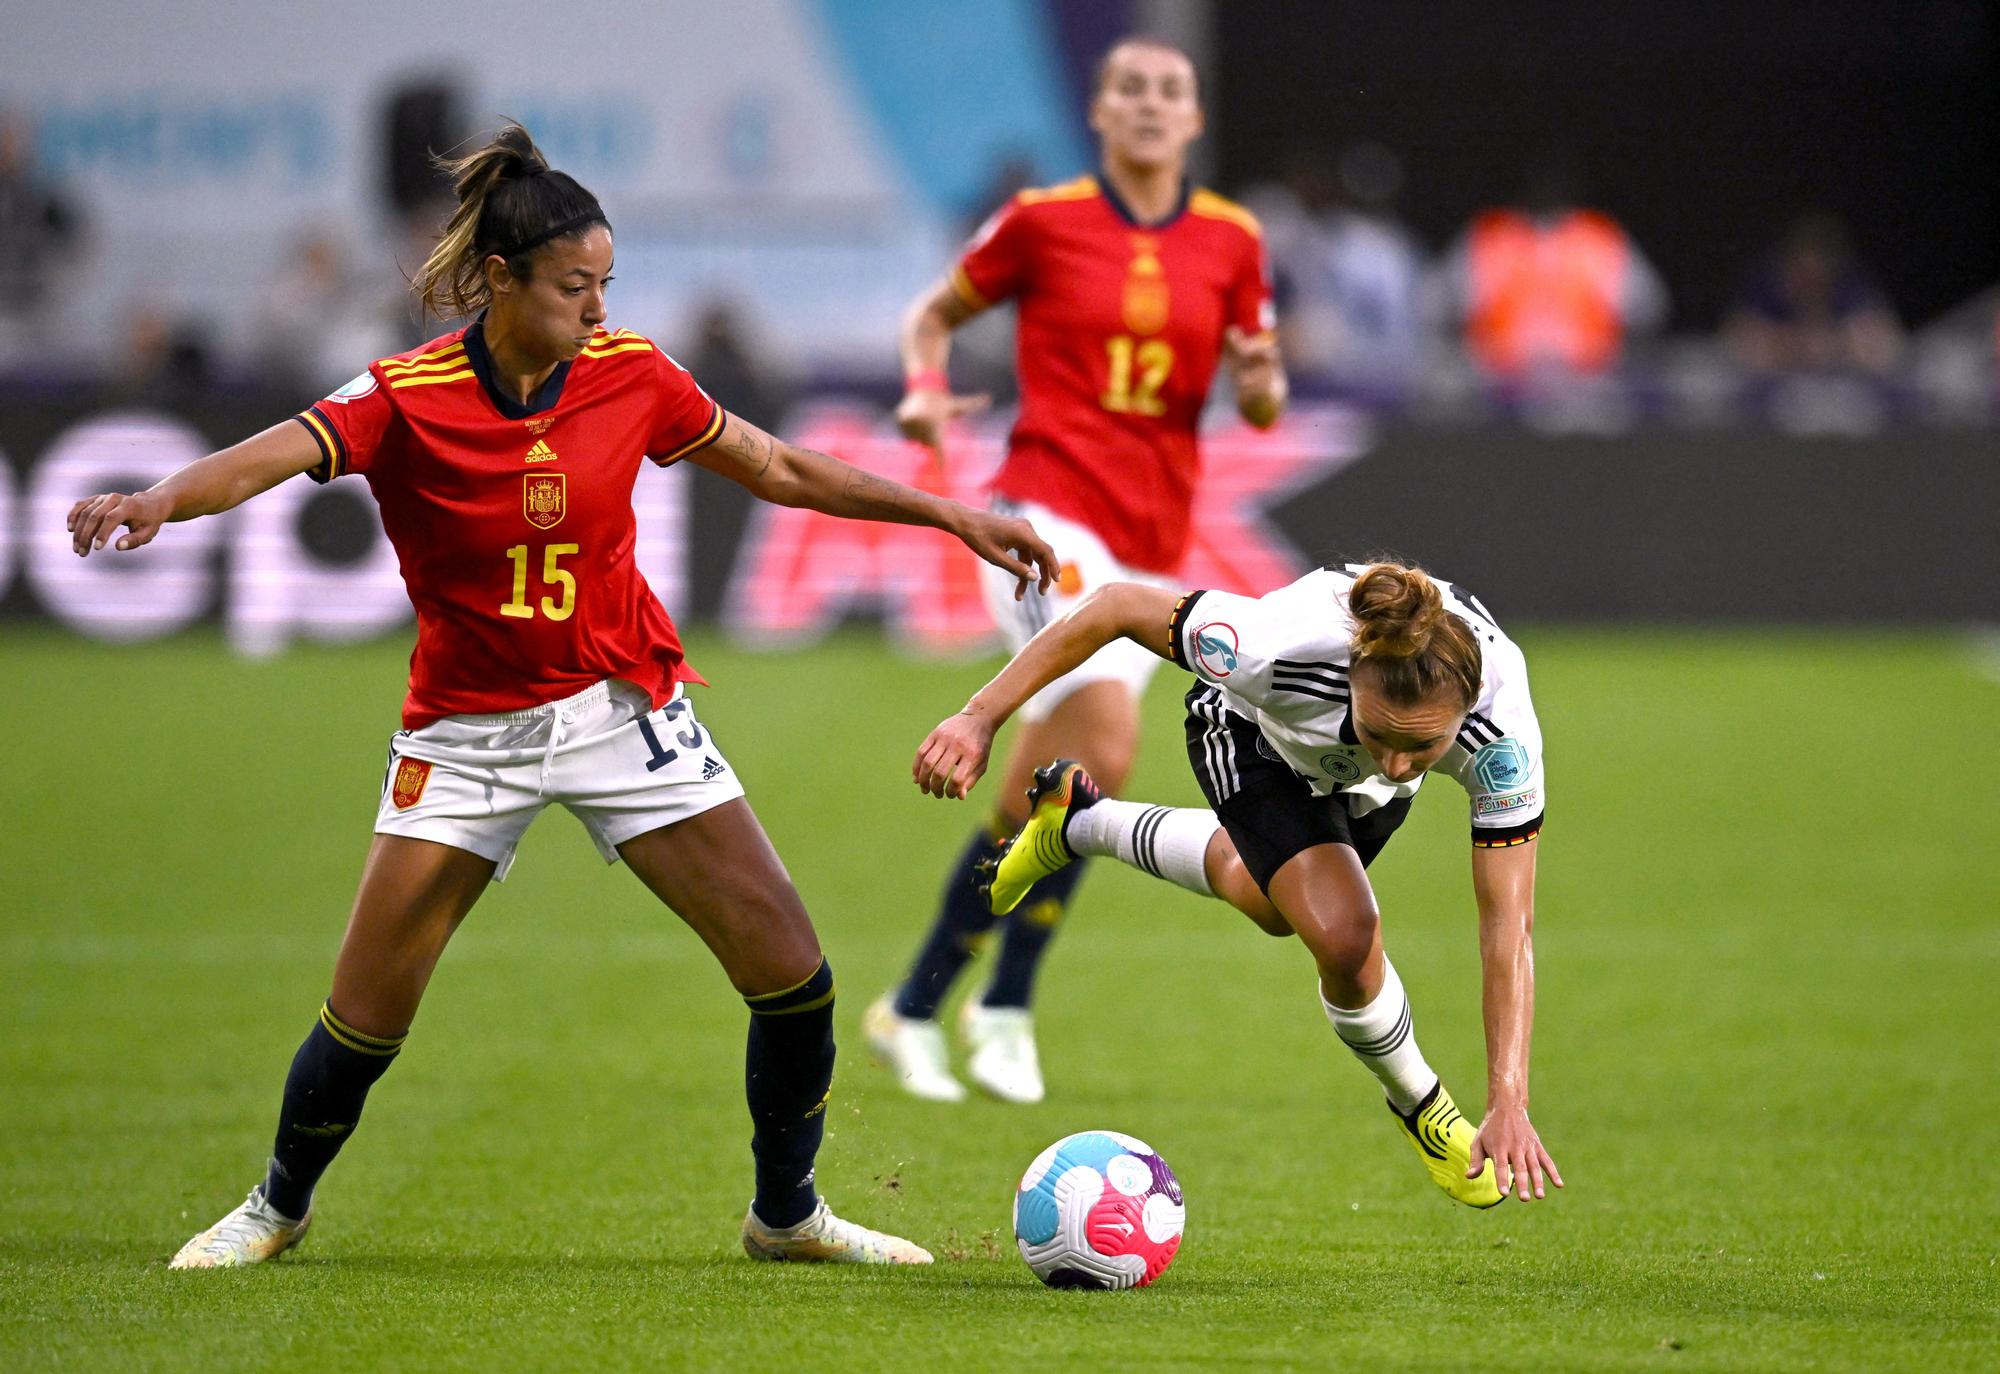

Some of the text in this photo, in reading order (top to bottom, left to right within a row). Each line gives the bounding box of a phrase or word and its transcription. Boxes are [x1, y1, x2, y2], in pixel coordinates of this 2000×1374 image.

[1100, 335, 1174, 417] 12
[525, 454, 558, 463] adidas
[500, 543, 579, 621] 15
[1491, 764, 1508, 773] play
